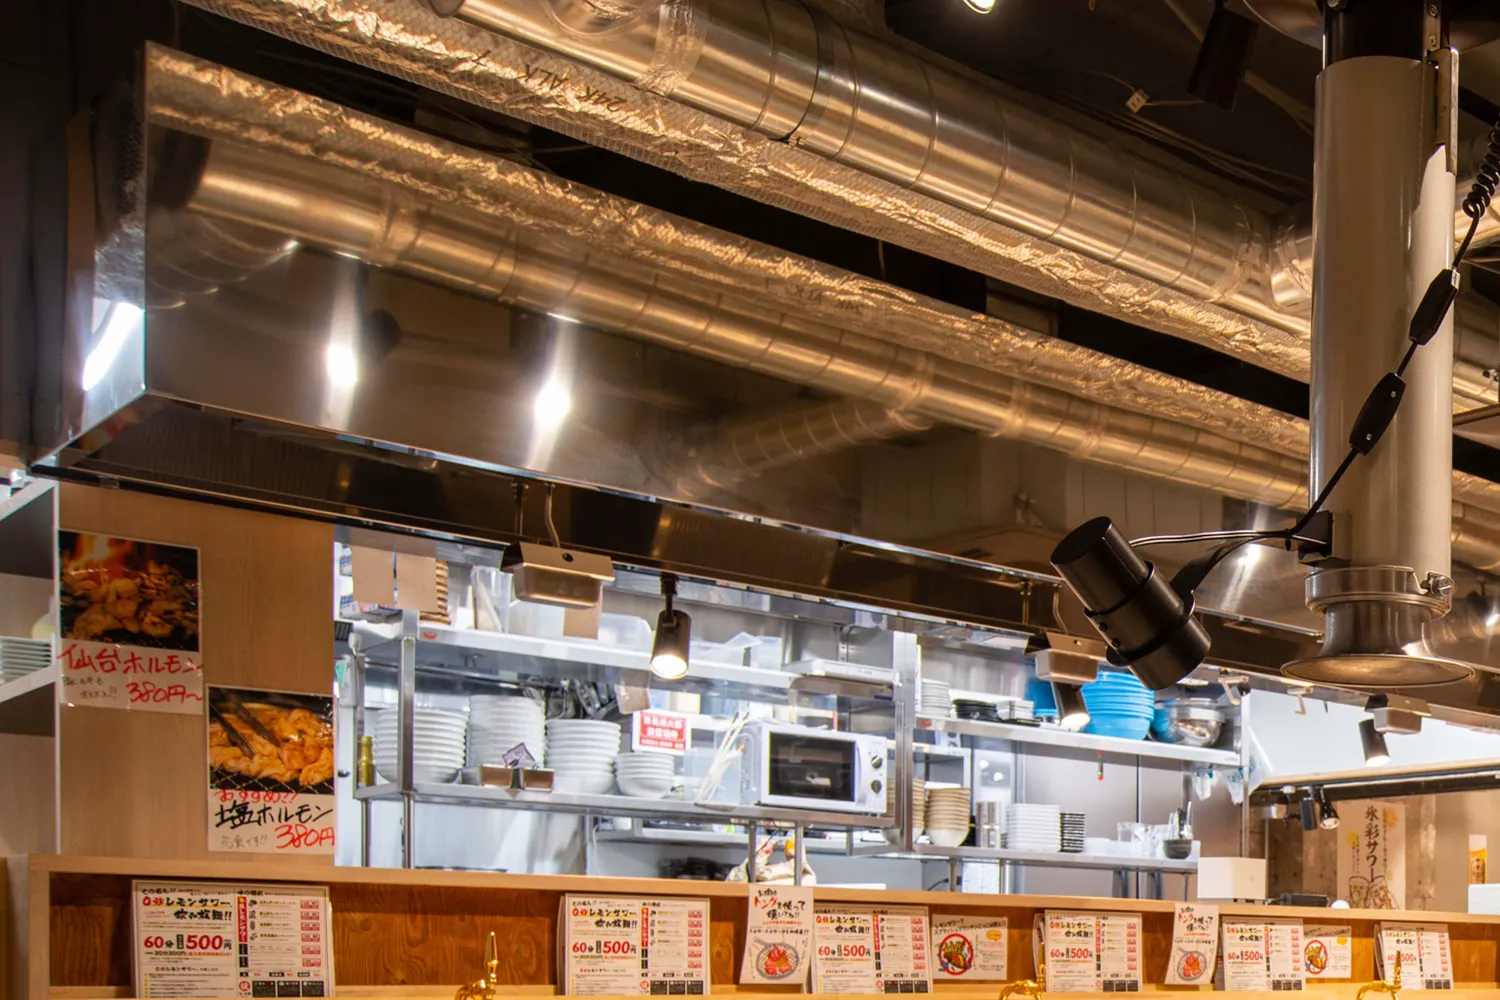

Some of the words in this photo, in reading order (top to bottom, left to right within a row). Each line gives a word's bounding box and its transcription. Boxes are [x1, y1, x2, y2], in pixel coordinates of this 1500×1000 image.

[57, 643, 204, 674] 仙台ホルモン
[214, 799, 334, 830] 塩ホルモン
[274, 823, 335, 849] 380円
[1364, 805, 1380, 883] 氷彩サワー
[173, 909, 232, 921] 飲み放題!!
[144, 935, 175, 949] 60分
[186, 934, 232, 951] 500円
[602, 940, 637, 955] 500円
